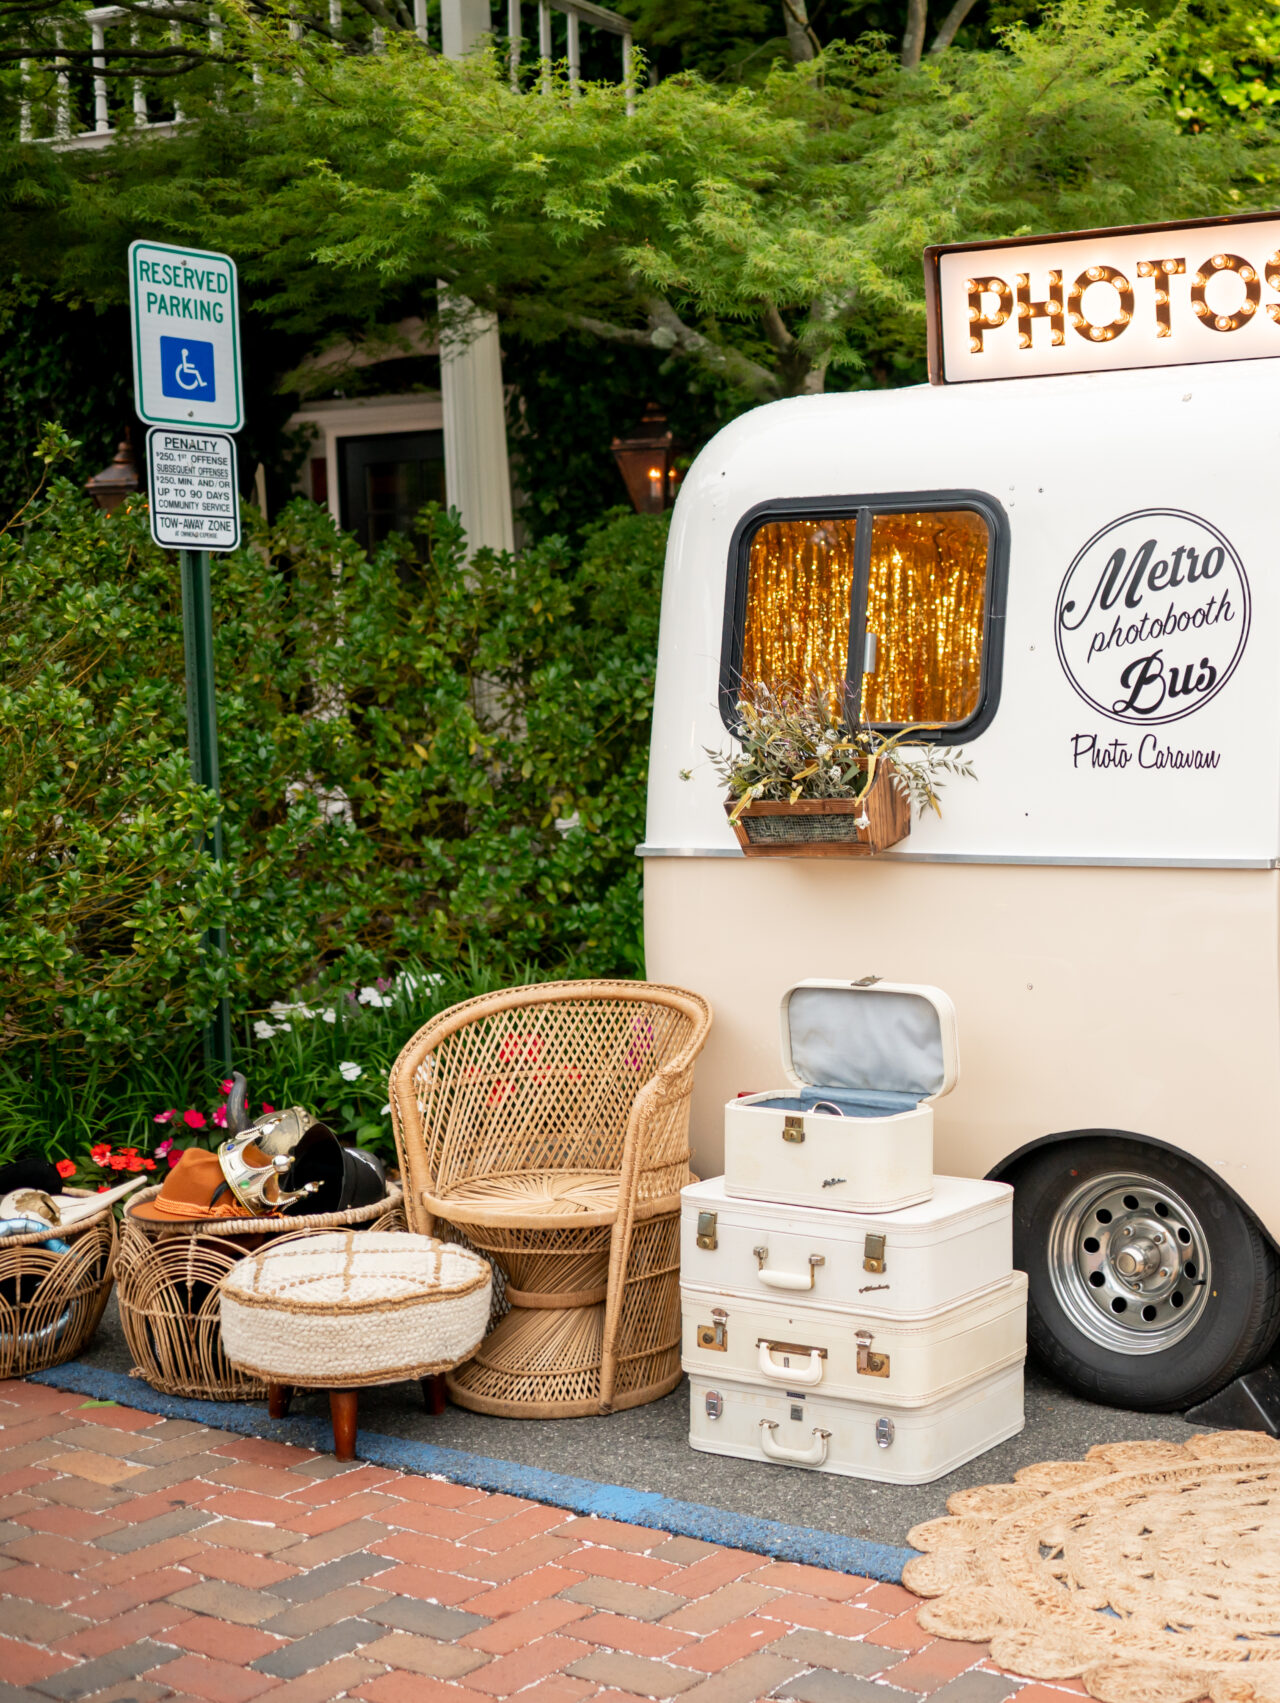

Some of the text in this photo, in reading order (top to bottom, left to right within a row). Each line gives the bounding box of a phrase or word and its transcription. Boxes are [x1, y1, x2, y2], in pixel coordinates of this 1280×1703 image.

[139, 260, 228, 294] RESERVED
[146, 291, 224, 324] PARKING
[164, 437, 218, 452] PENALTY
[190, 455, 228, 466] OFFENSE
[156, 463, 229, 478] SUBSEQUENT OFFENSES
[178, 477, 194, 486] MIN.
[198, 479, 230, 488] AND/OR
[157, 487, 230, 500] UP TO 90 DAYS
[158, 499, 230, 512] COMMUNITY SERVICE
[160, 516, 232, 532] TOW-AWAY ZONE
[1061, 538, 1226, 631] Metro
[1087, 588, 1235, 664] photobooth
[1112, 649, 1218, 715] Bus
[1070, 733, 1221, 770] Photo Caravan
